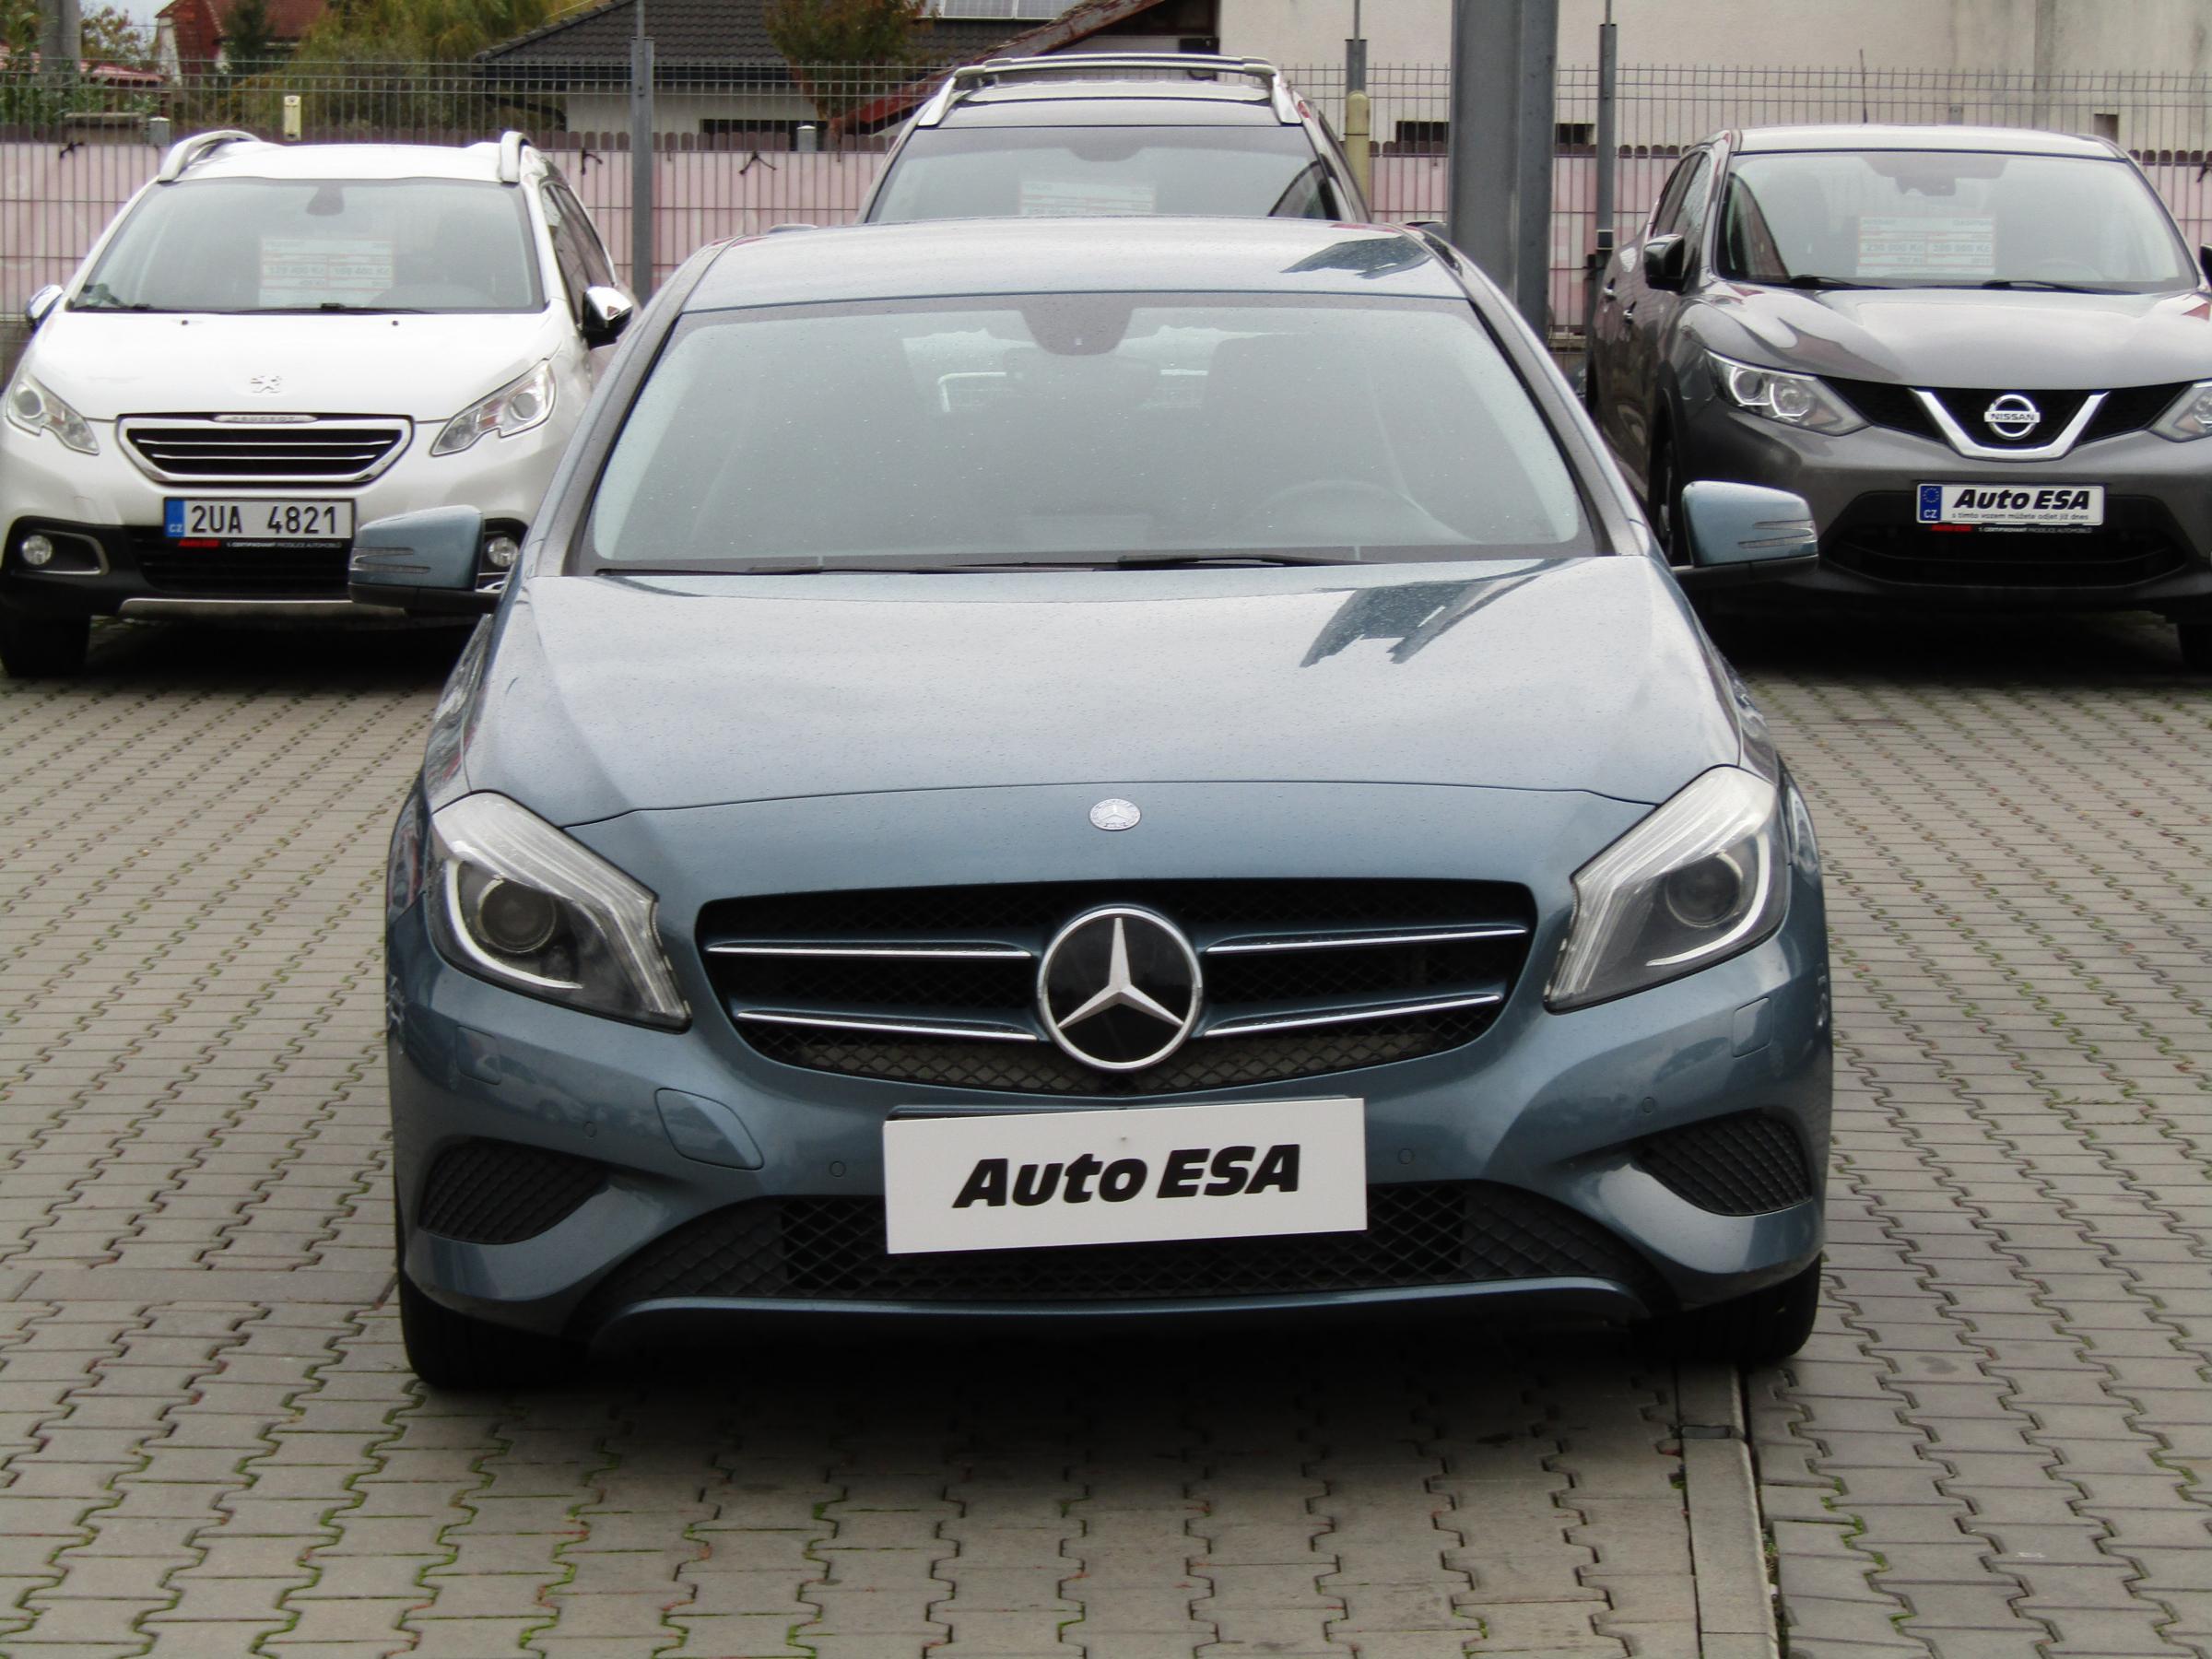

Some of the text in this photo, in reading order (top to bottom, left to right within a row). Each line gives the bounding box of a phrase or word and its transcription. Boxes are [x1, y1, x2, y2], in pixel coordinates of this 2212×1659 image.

[1990, 412, 2035, 421] NISSAN
[1953, 488, 2090, 510] Auto ESA
[1924, 509, 1937, 519] CZ
[2071, 512, 2089, 521] dnes
[191, 505, 335, 534] 2UA 4821
[169, 523, 183, 533] CZ
[951, 1143, 1301, 1209] Auto ESA
